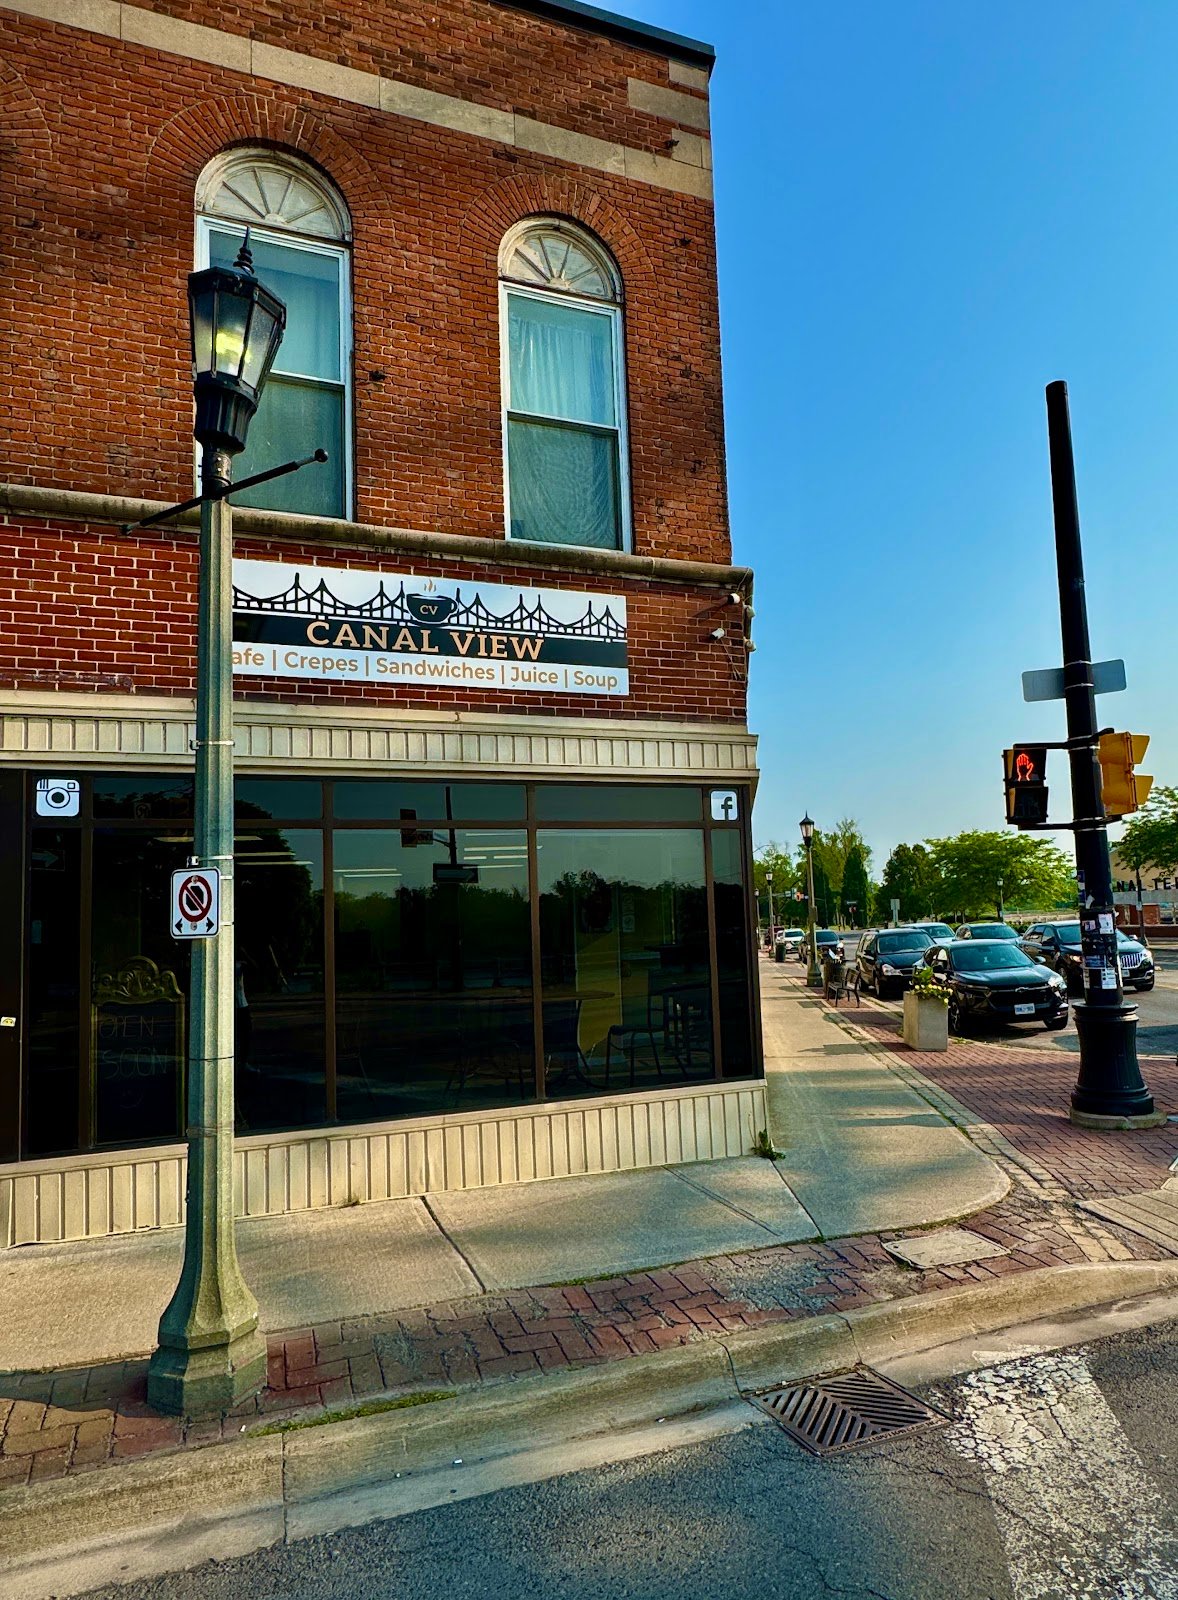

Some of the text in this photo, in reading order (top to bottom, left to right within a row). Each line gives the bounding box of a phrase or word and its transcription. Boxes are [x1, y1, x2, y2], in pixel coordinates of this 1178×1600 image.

[419, 604, 439, 616] CV
[306, 620, 545, 660] CANAL VIEW
[231, 647, 618, 691] afe Crepes Sandwiches Juice Soup
[98, 1015, 154, 1040] OPEN
